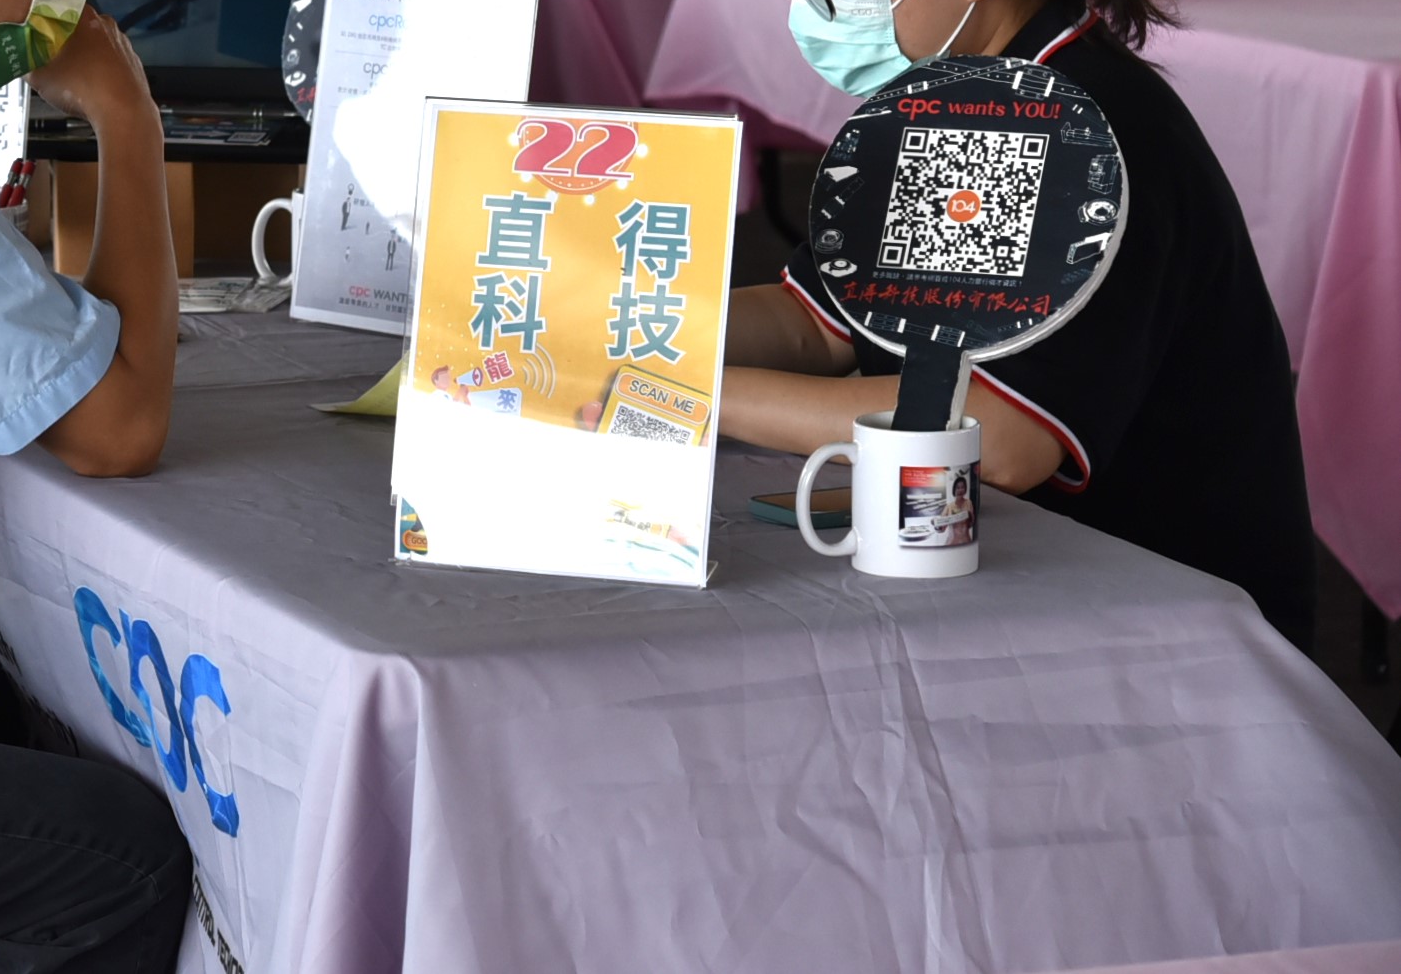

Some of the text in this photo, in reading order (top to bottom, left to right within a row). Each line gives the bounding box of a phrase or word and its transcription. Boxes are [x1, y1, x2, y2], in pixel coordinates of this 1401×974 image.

[898, 98, 1062, 121] cpc wants YOU!
[513, 119, 639, 181] 22
[951, 199, 976, 213] 104
[483, 351, 514, 383] 龍
[629, 380, 696, 414] SCAN ME
